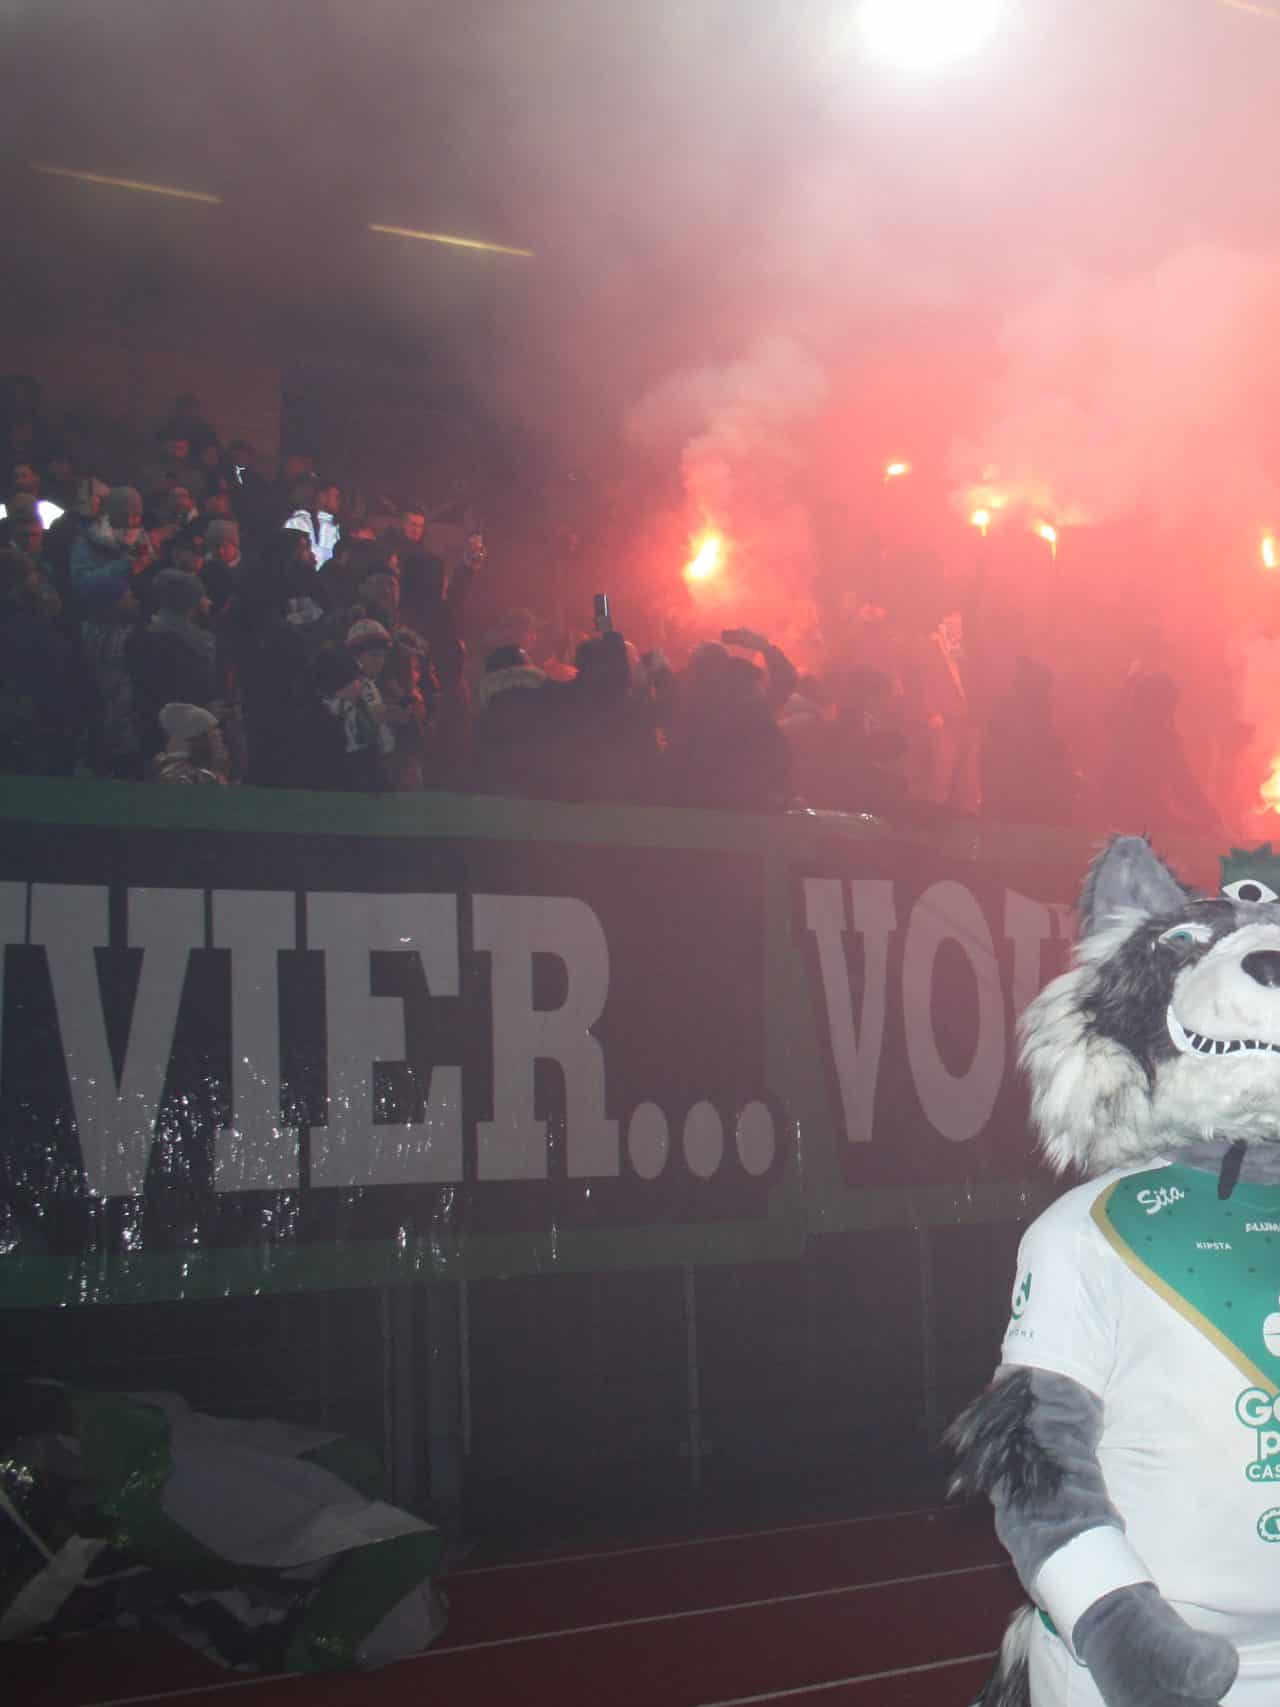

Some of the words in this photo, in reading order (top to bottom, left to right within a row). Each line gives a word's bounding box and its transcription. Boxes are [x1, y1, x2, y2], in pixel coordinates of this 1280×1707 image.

[0, 881, 776, 1197] VIER...
[804, 878, 1076, 1143] VO
[1136, 1186, 1185, 1215] Sita
[1195, 1241, 1233, 1251] KIPSTA
